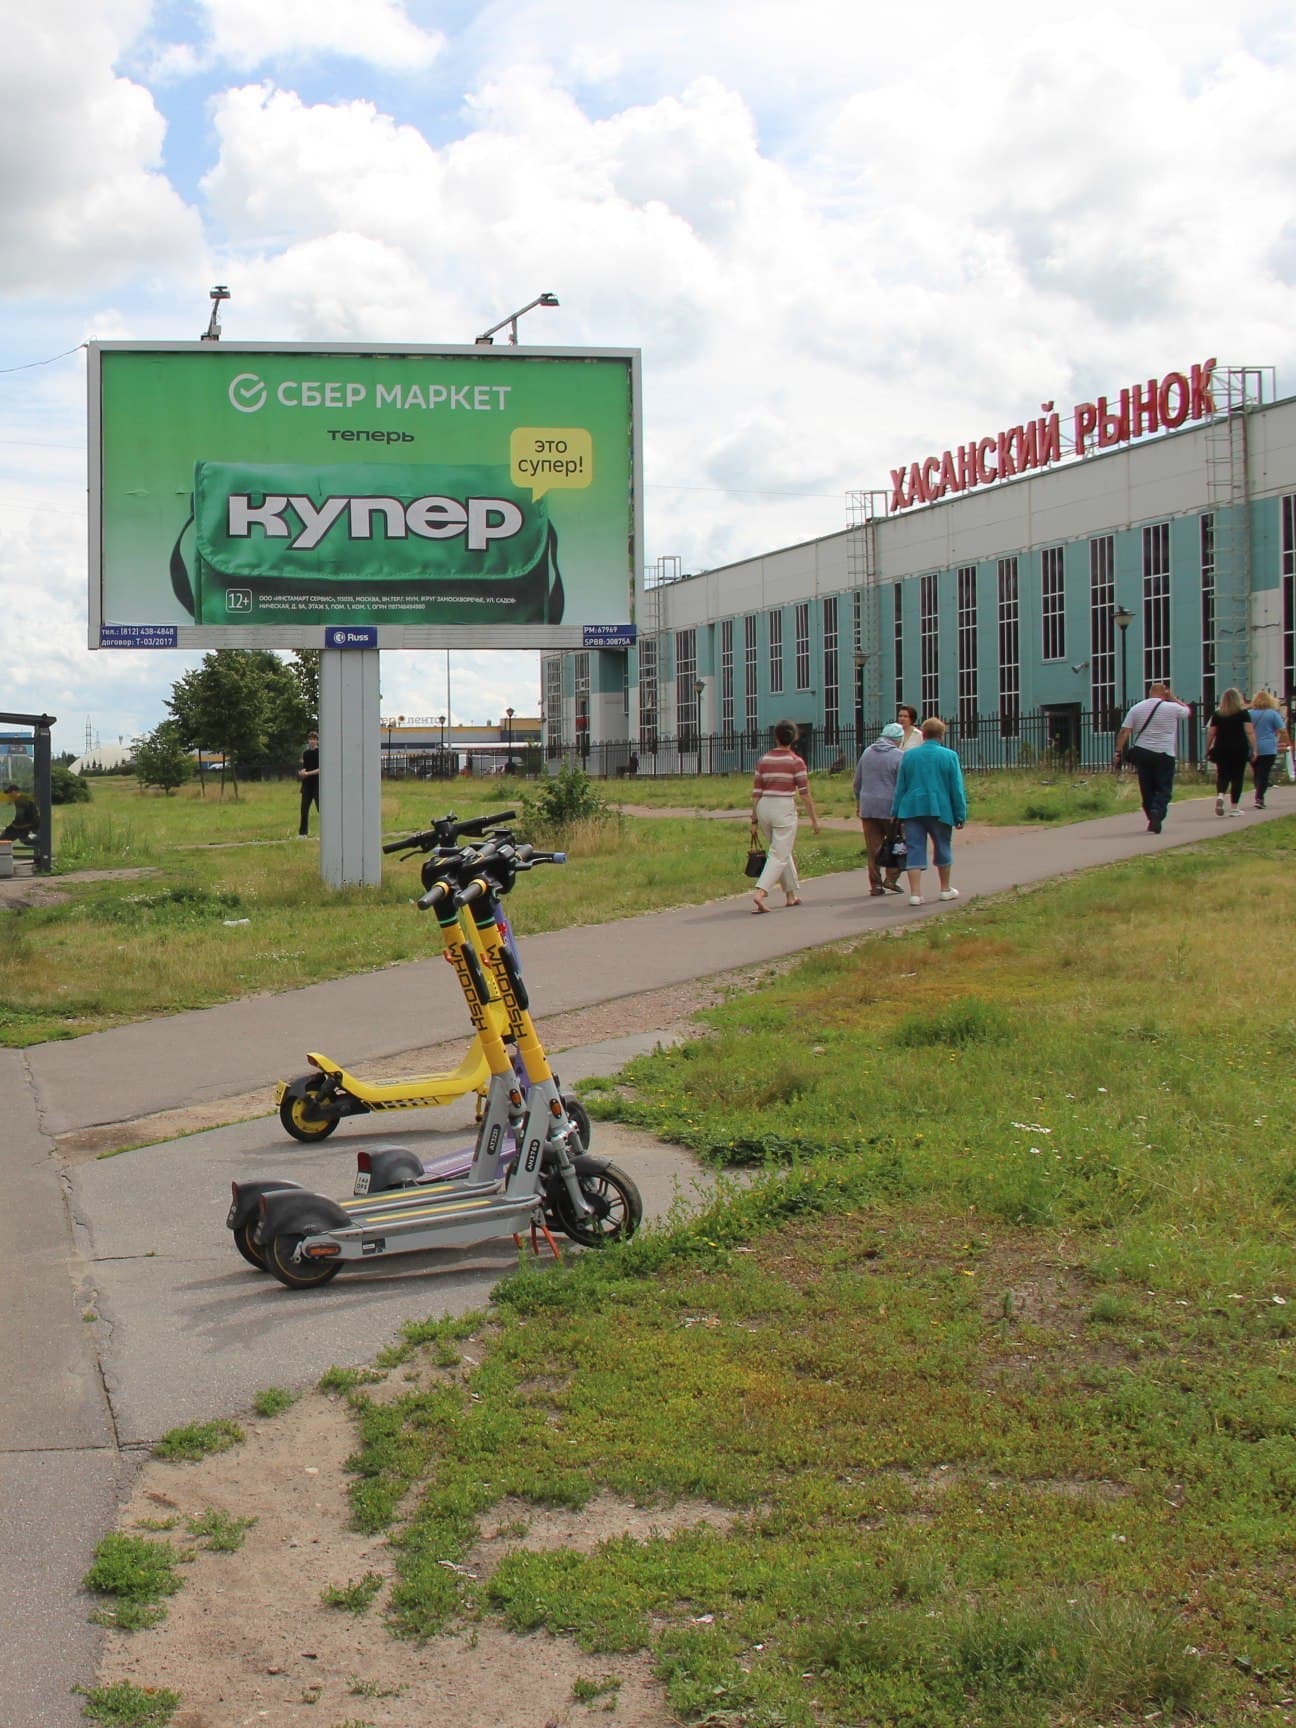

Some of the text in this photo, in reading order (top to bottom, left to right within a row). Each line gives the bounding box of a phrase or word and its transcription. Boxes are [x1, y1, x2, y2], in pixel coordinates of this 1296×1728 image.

[277, 381, 512, 410] СБЕР МАРКЕТ
[327, 429, 415, 444] теперь
[534, 440, 568, 453] это
[890, 358, 1217, 512] ХАСАНСКИЙ РЫНОК
[518, 456, 584, 477] супер!
[227, 493, 524, 551] купер
[228, 593, 249, 608] 12+
[347, 633, 369, 641] Russ
[448, 942, 488, 1031] WHOOSH
[486, 944, 528, 1038] WHOOSH
